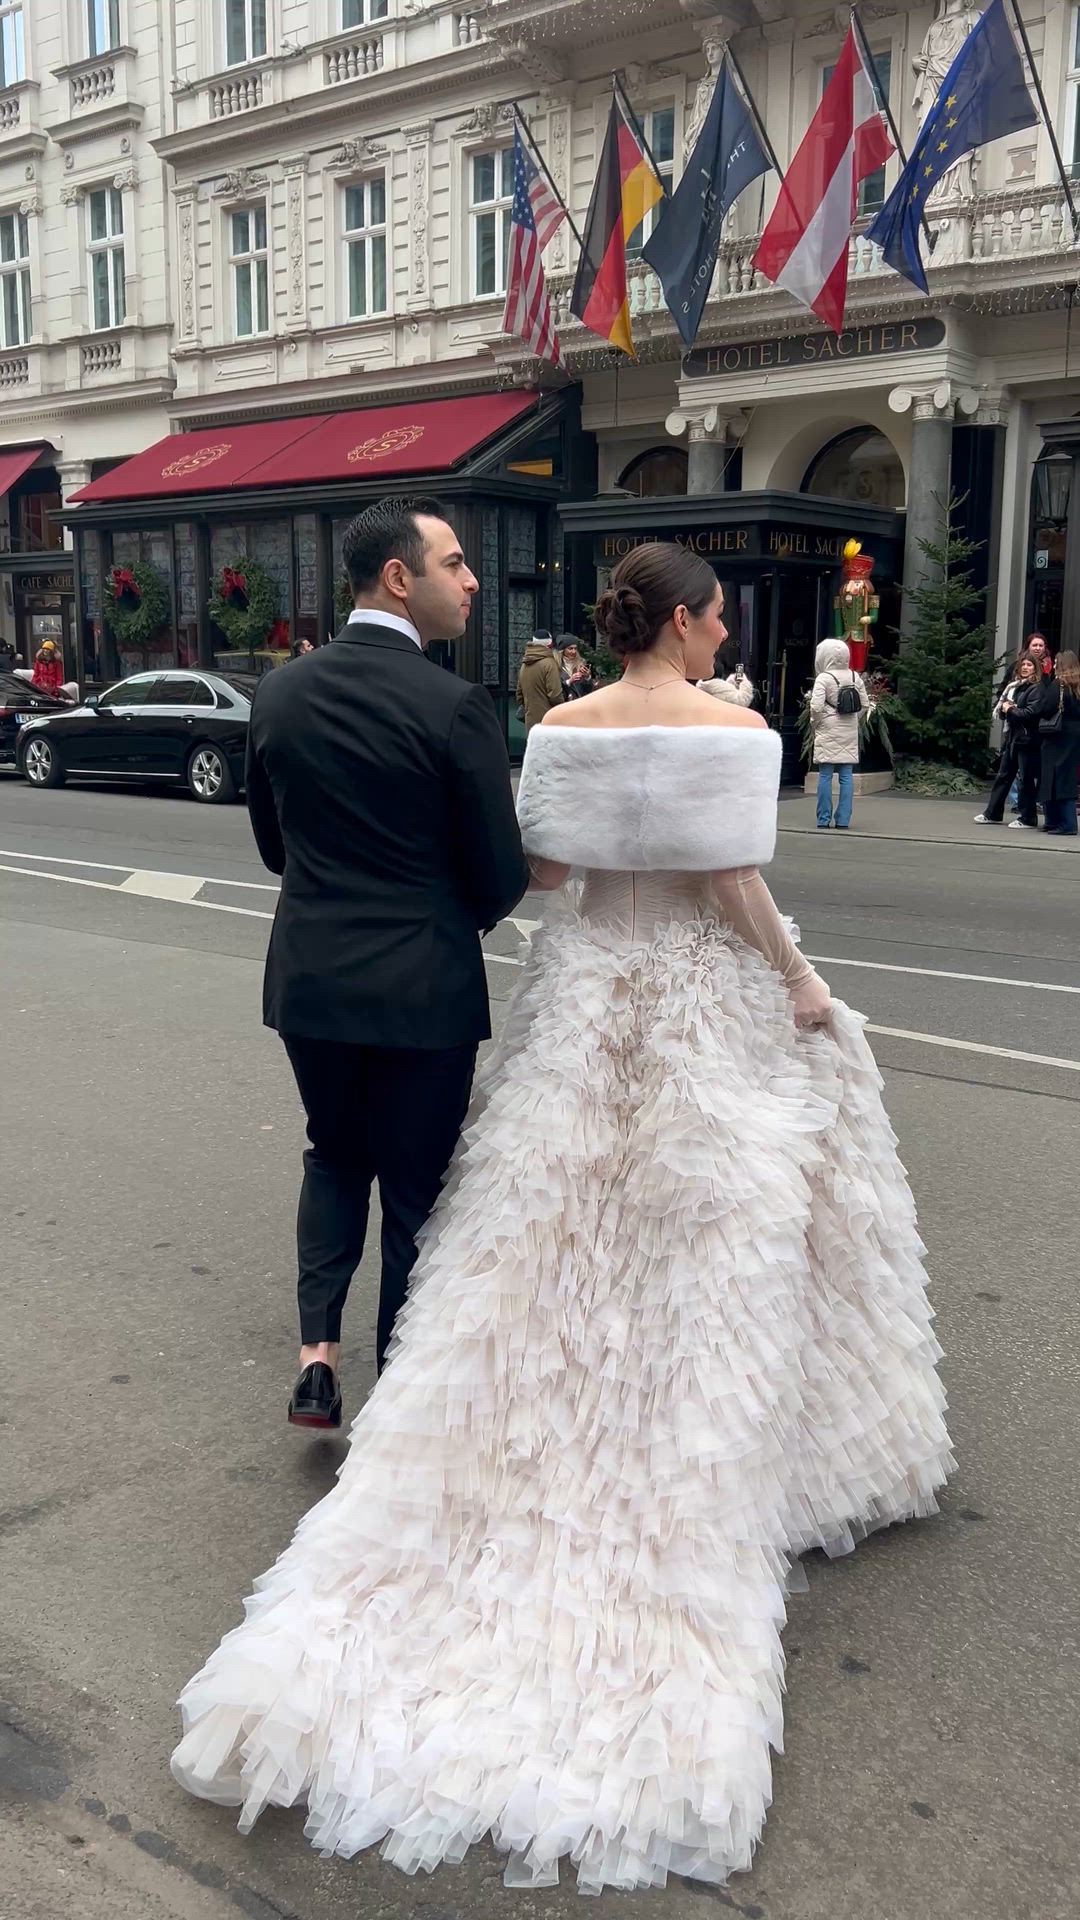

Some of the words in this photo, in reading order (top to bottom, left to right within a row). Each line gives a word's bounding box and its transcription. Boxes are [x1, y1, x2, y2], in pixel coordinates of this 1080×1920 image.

[706, 342, 790, 373] HOTEL
[802, 323, 919, 360] SACHER
[769, 531, 810, 554] HOTEL
[47, 575, 75, 588] SACHE
